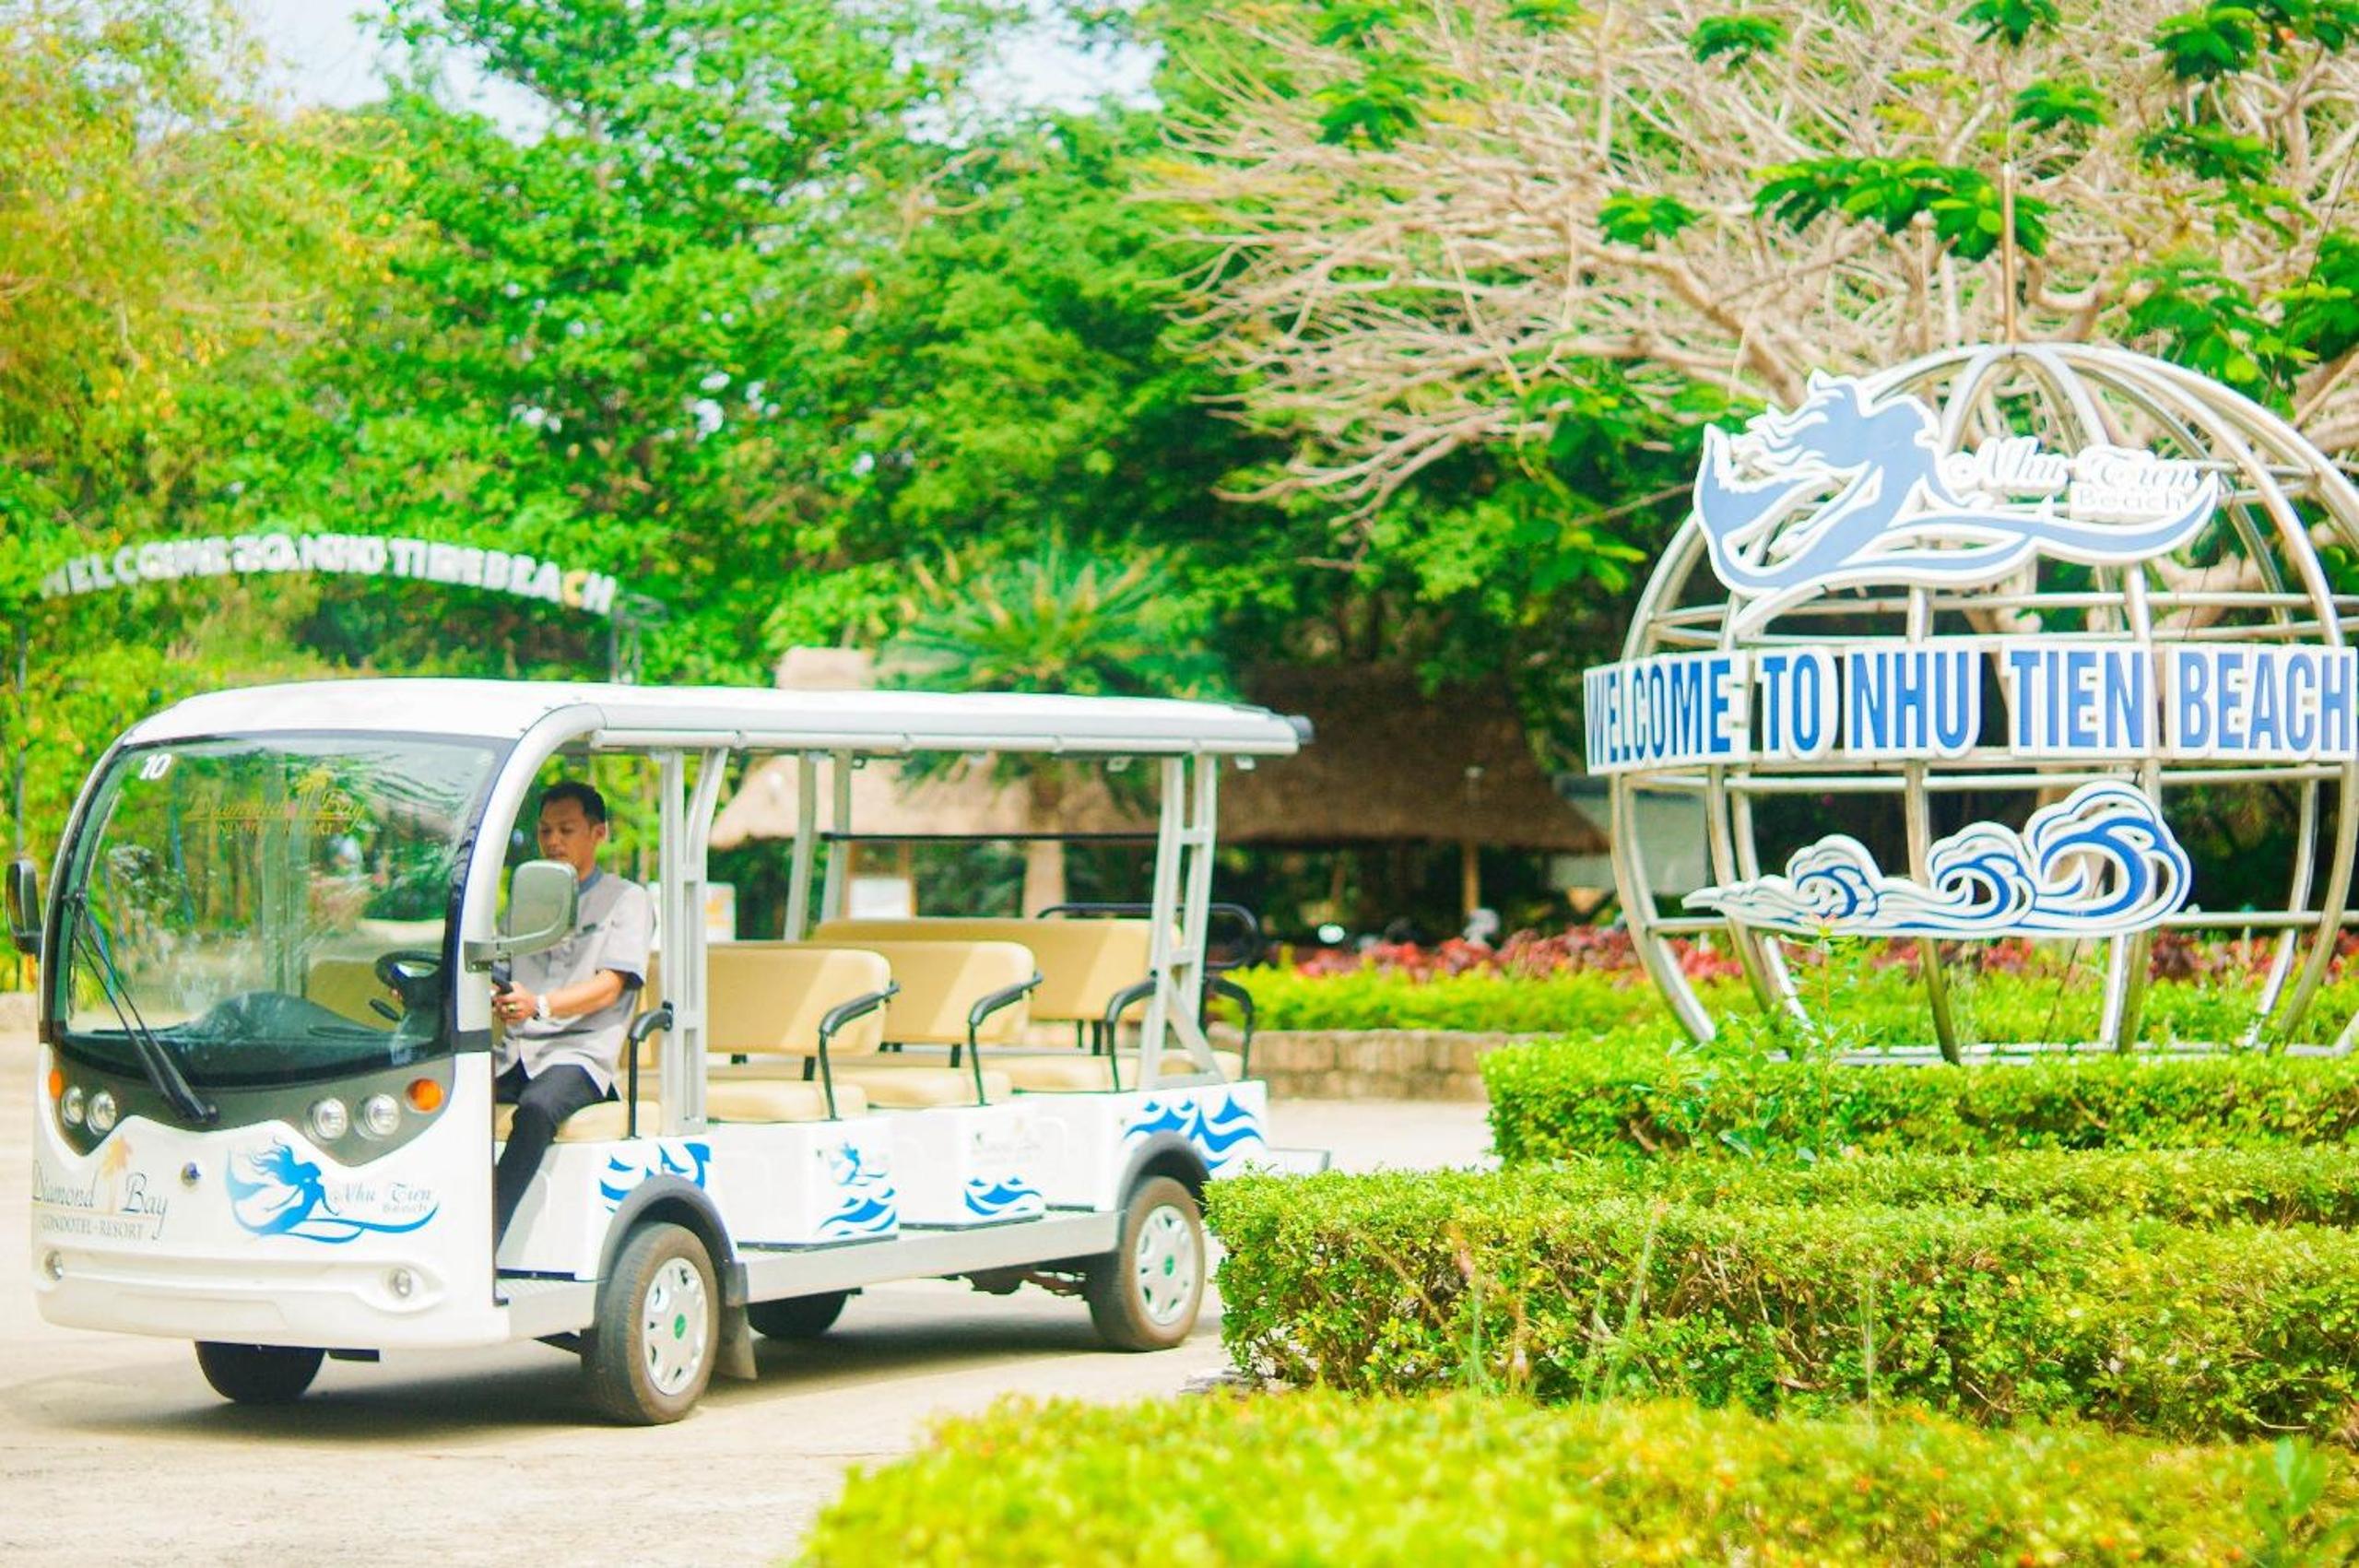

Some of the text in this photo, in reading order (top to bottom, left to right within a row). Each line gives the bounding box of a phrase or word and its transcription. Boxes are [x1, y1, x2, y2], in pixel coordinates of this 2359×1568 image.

[2076, 487, 2185, 513] Beach
[1586, 649, 2352, 767] WELCOME TO NHU TIEN BEACH
[139, 754, 171, 780] 10
[120, 1172, 170, 1241] Bay
